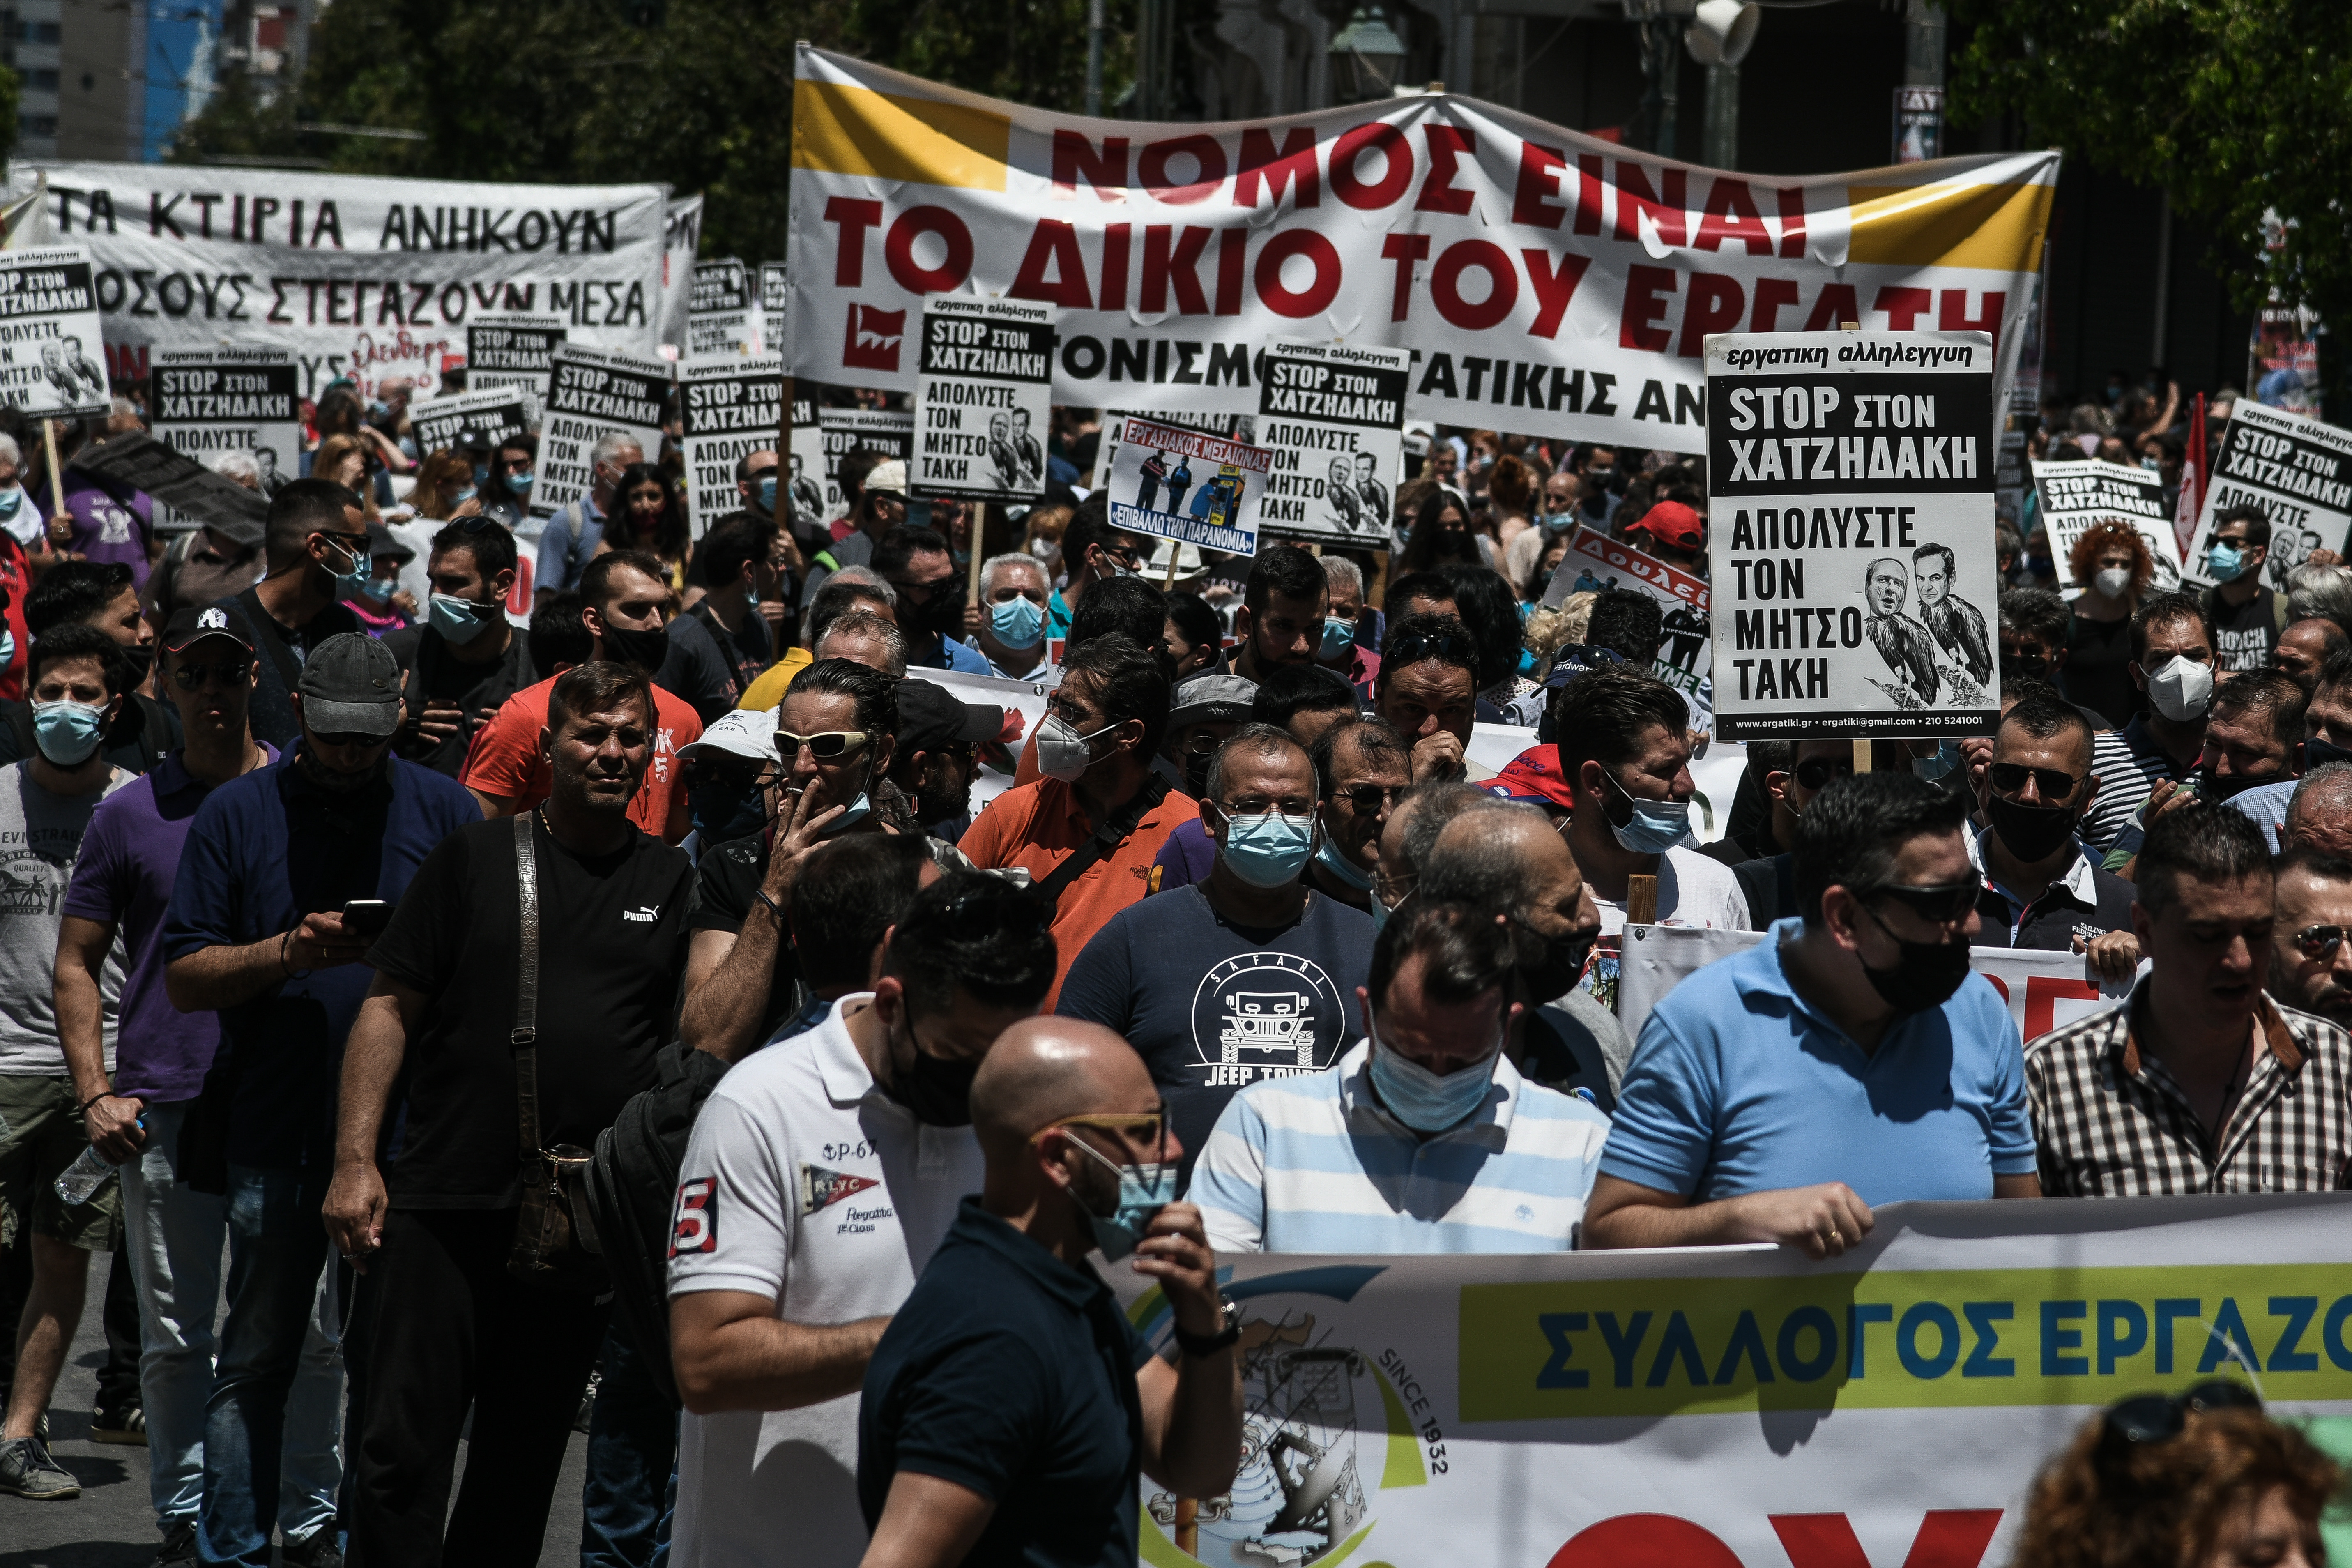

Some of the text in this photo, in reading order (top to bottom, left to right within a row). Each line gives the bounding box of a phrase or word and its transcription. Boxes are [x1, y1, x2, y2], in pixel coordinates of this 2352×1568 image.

[1052, 122, 1807, 259] ΝΟΜΟΣ ΕΙΝΑΙ
[48, 185, 118, 234] ΤΑ
[151, 193, 344, 249] ΚΤΙΡΙΑ
[379, 204, 617, 253] ΑΝΗΚΟΥΝ
[824, 196, 975, 295] ΤΟ
[1007, 218, 1342, 318] ΔΙΚΙΟ
[1381, 233, 1592, 341] ΤΟΥ
[0, 271, 21, 293] OP
[0, 287, 88, 315] ΤΖΗΔΑΚΗ
[95, 269, 648, 327] ΟΣΟΥΣ ΣΤΕΓΑΖΟΥΝ ΜΕΣΑ
[934, 300, 1047, 319] εργατικη αλληλεγγυη
[1, 321, 62, 341] ΟΛΥΣΤΕ
[474, 330, 547, 349] STOP ΣΤΟΝ
[931, 319, 1029, 350] STOP ΣΤΟΝ
[475, 350, 553, 368] ΧΑΤΖΗΔΑΚ
[930, 345, 1045, 377] ΧΑΤΖΗΔΑΚΗ
[1276, 343, 1399, 366] εργατικη αλληλεγγυη
[1727, 341, 1972, 370] εργατικη αλληλεγγυη
[0, 366, 42, 385] ΗΤΣΟ
[162, 370, 269, 393] STOP ΣΤΟΝ
[558, 364, 647, 399] STOP ΣΤΟΝ
[687, 359, 782, 379] εργατικη αλληλε
[1054, 333, 1705, 427] ΟΝΙΣΜ ΑΤΙΚΗΣ ΑΝ
[1273, 362, 1378, 396] STOP ΣΤΟΝ
[162, 394, 290, 418] ΧΑΤΖΗΔΑΚΗ
[555, 387, 660, 424] ΧΑΤΖΗΔΑΚΗ
[688, 381, 742, 408] STOP
[927, 382, 1015, 409] ΑΠΟΛΥΣΤΕ
[1269, 387, 1396, 424] ΧΑΤΖΗΔΑΚΗ
[926, 407, 961, 429] ΤΟΝ
[1729, 386, 1935, 431] STOP ΣΤΟΝ
[164, 429, 258, 451] ΑΠΟΛΥΣΤΕ
[420, 415, 464, 441] STOP
[551, 419, 631, 442] ΑΠΟΛΥ
[1266, 424, 1360, 452] ΑΠΟΛΥΣΤΕ
[2243, 409, 2352, 449] εργατικη αλληλεγγυ
[549, 440, 580, 461] ΤΟΝ
[822, 432, 857, 453] TOP
[925, 432, 986, 456] ΜΗΤΣΟ
[1127, 422, 1202, 456] ΕΡΓΑΣΙΑΚΟΣ
[1201, 440, 1271, 473] ΜΕΣΑΙΩΝΑΣ
[2234, 427, 2339, 478] STOP ΣΤΟΝ
[923, 456, 969, 480] ΤΑΚΗ
[1270, 449, 1300, 471] ΟΝ
[1729, 437, 1977, 481] ΧΑΤΖΗΔΑΚΗ
[695, 466, 730, 486] ΤΟΝ
[2046, 477, 2142, 498] STOP ΣΤΟΝ
[2225, 450, 2352, 509] ΧΑΤΖΗΔΑΚΗ
[542, 484, 582, 504] ΤΑΚΗ
[700, 489, 745, 510] ΜΗΤ
[2048, 492, 2163, 517] ΧΑΤΖΗΔΑΚΗ
[1167, 516, 1186, 536] ΤΗΝ
[1731, 507, 1916, 550] ΑΠΟΛΥΣΤΕ
[1581, 539, 1709, 606] Δουλεί
[1731, 558, 1804, 601] ΤΟΝ
[1735, 606, 1862, 650] ΜΗΤΣΟ
[1553, 661, 1590, 673] Hardwar
[1733, 657, 1829, 700] ΤΑΚΗ
[1736, 716, 1983, 728] www.ergatiki.gr ergatiki@gmail.com 210 5241001
[2, 828, 80, 843] EVI STRAU
[14, 864, 45, 873] QUALITY
[624, 910, 653, 922] PUMA
[2080, 922, 2106, 935] SAILING
[2072, 925, 2100, 939] FEDERA
[1210, 955, 1325, 984] SAFARI
[1204, 1066, 1253, 1087] JEEP
[673, 1183, 710, 1250] 5
[1536, 1301, 2015, 1390] ΣΥΛΛΟΓΟΣ
[1379, 1348, 1449, 1475] SINCE 1932
